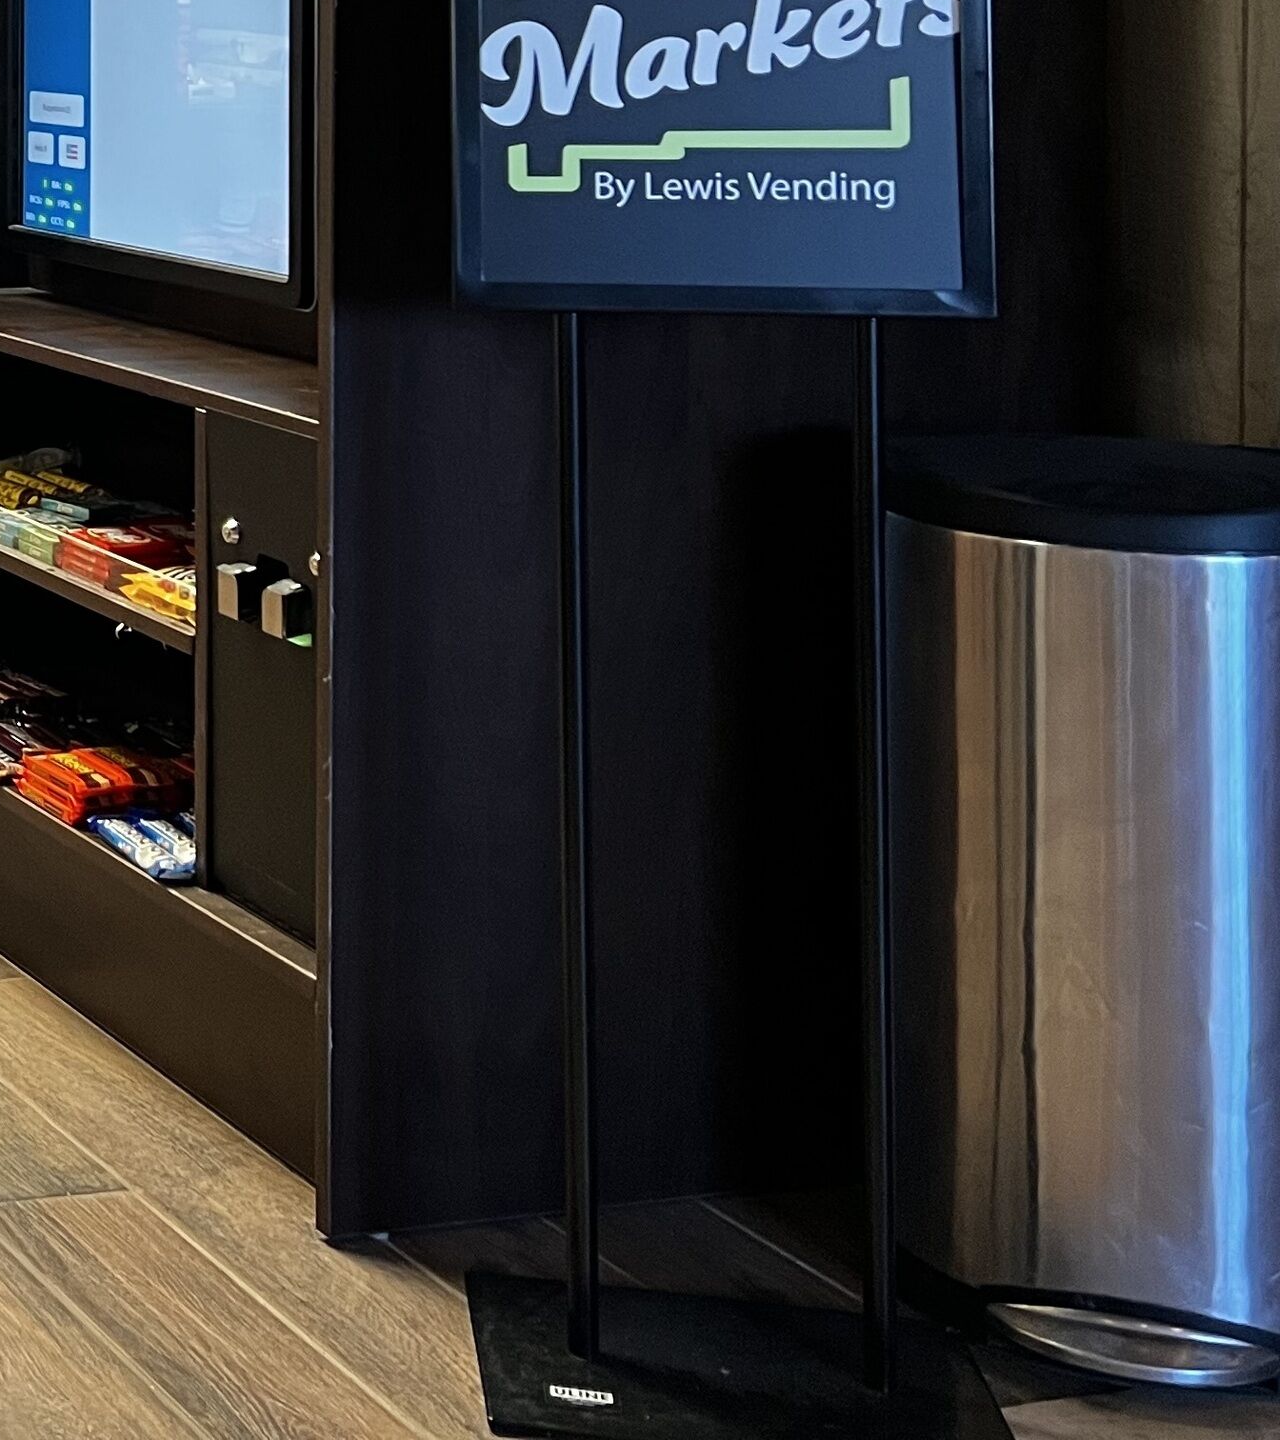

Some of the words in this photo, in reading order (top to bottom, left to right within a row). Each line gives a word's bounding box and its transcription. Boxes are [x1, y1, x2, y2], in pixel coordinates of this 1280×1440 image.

[593, 170, 636, 208] By
[644, 170, 741, 203] Lewis
[747, 170, 897, 210] Vending
[553, 1387, 611, 1401] ULINE
